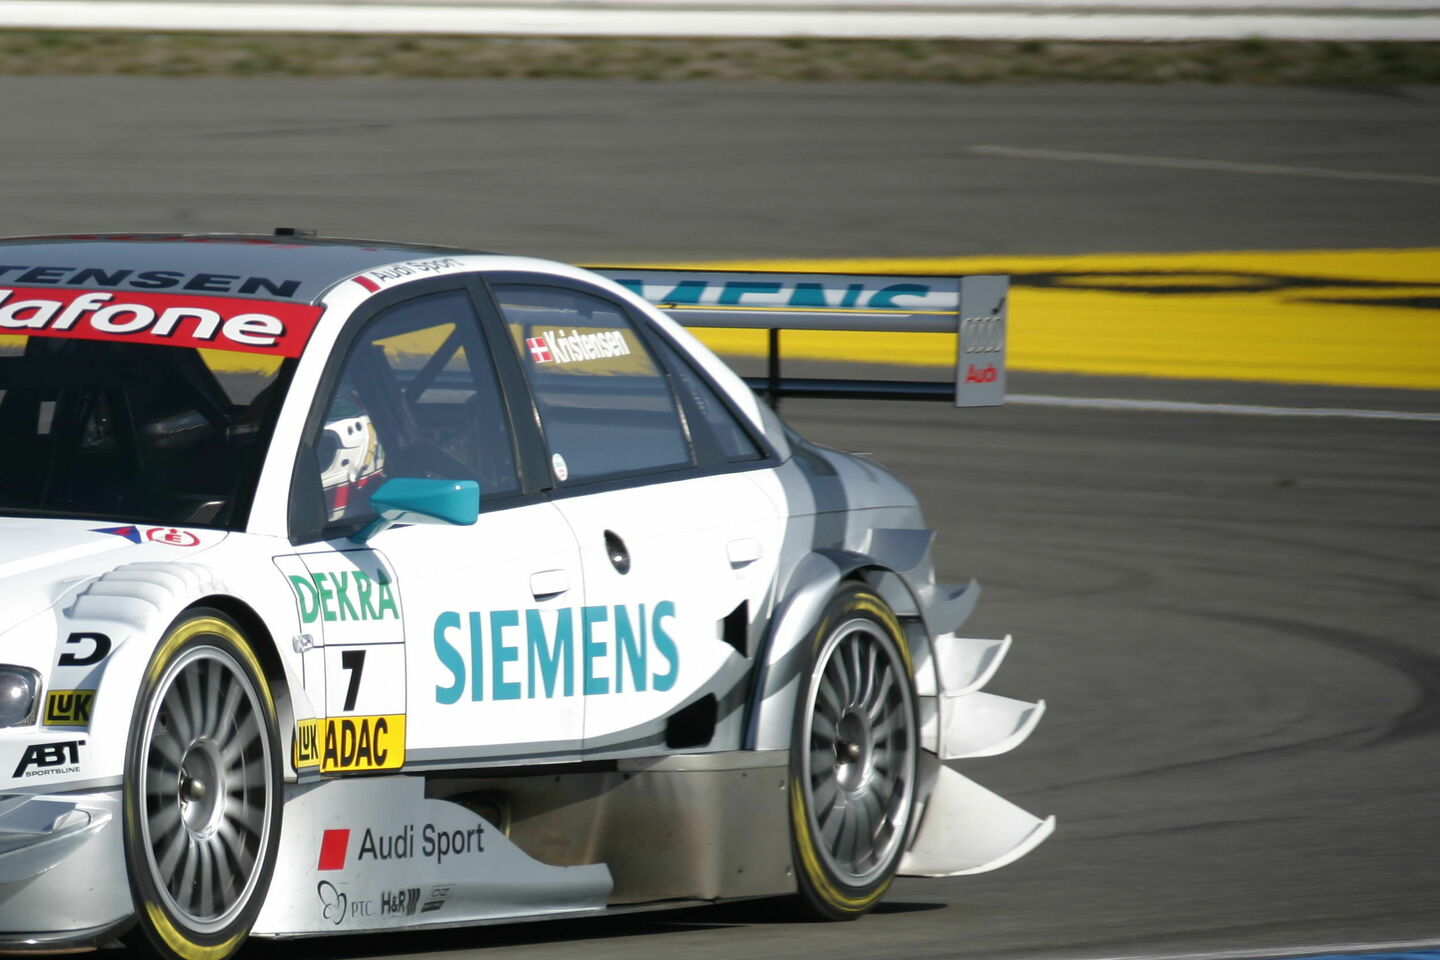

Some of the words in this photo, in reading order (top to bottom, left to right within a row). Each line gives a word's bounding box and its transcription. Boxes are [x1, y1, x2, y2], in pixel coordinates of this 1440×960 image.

[543, 329, 631, 364] Kristensen
[964, 363, 999, 384] Audi
[288, 568, 400, 623] DEKRA
[433, 600, 679, 705] SIEMENS
[342, 649, 366, 712] 7
[12, 739, 86, 778] ABT
[322, 717, 389, 770] ADAC
[26, 766, 81, 778] SPORTSLINE
[358, 824, 414, 860] Audi
[422, 823, 485, 864] Sport
[351, 900, 374, 918] PTC
[380, 889, 406, 915] H&R
